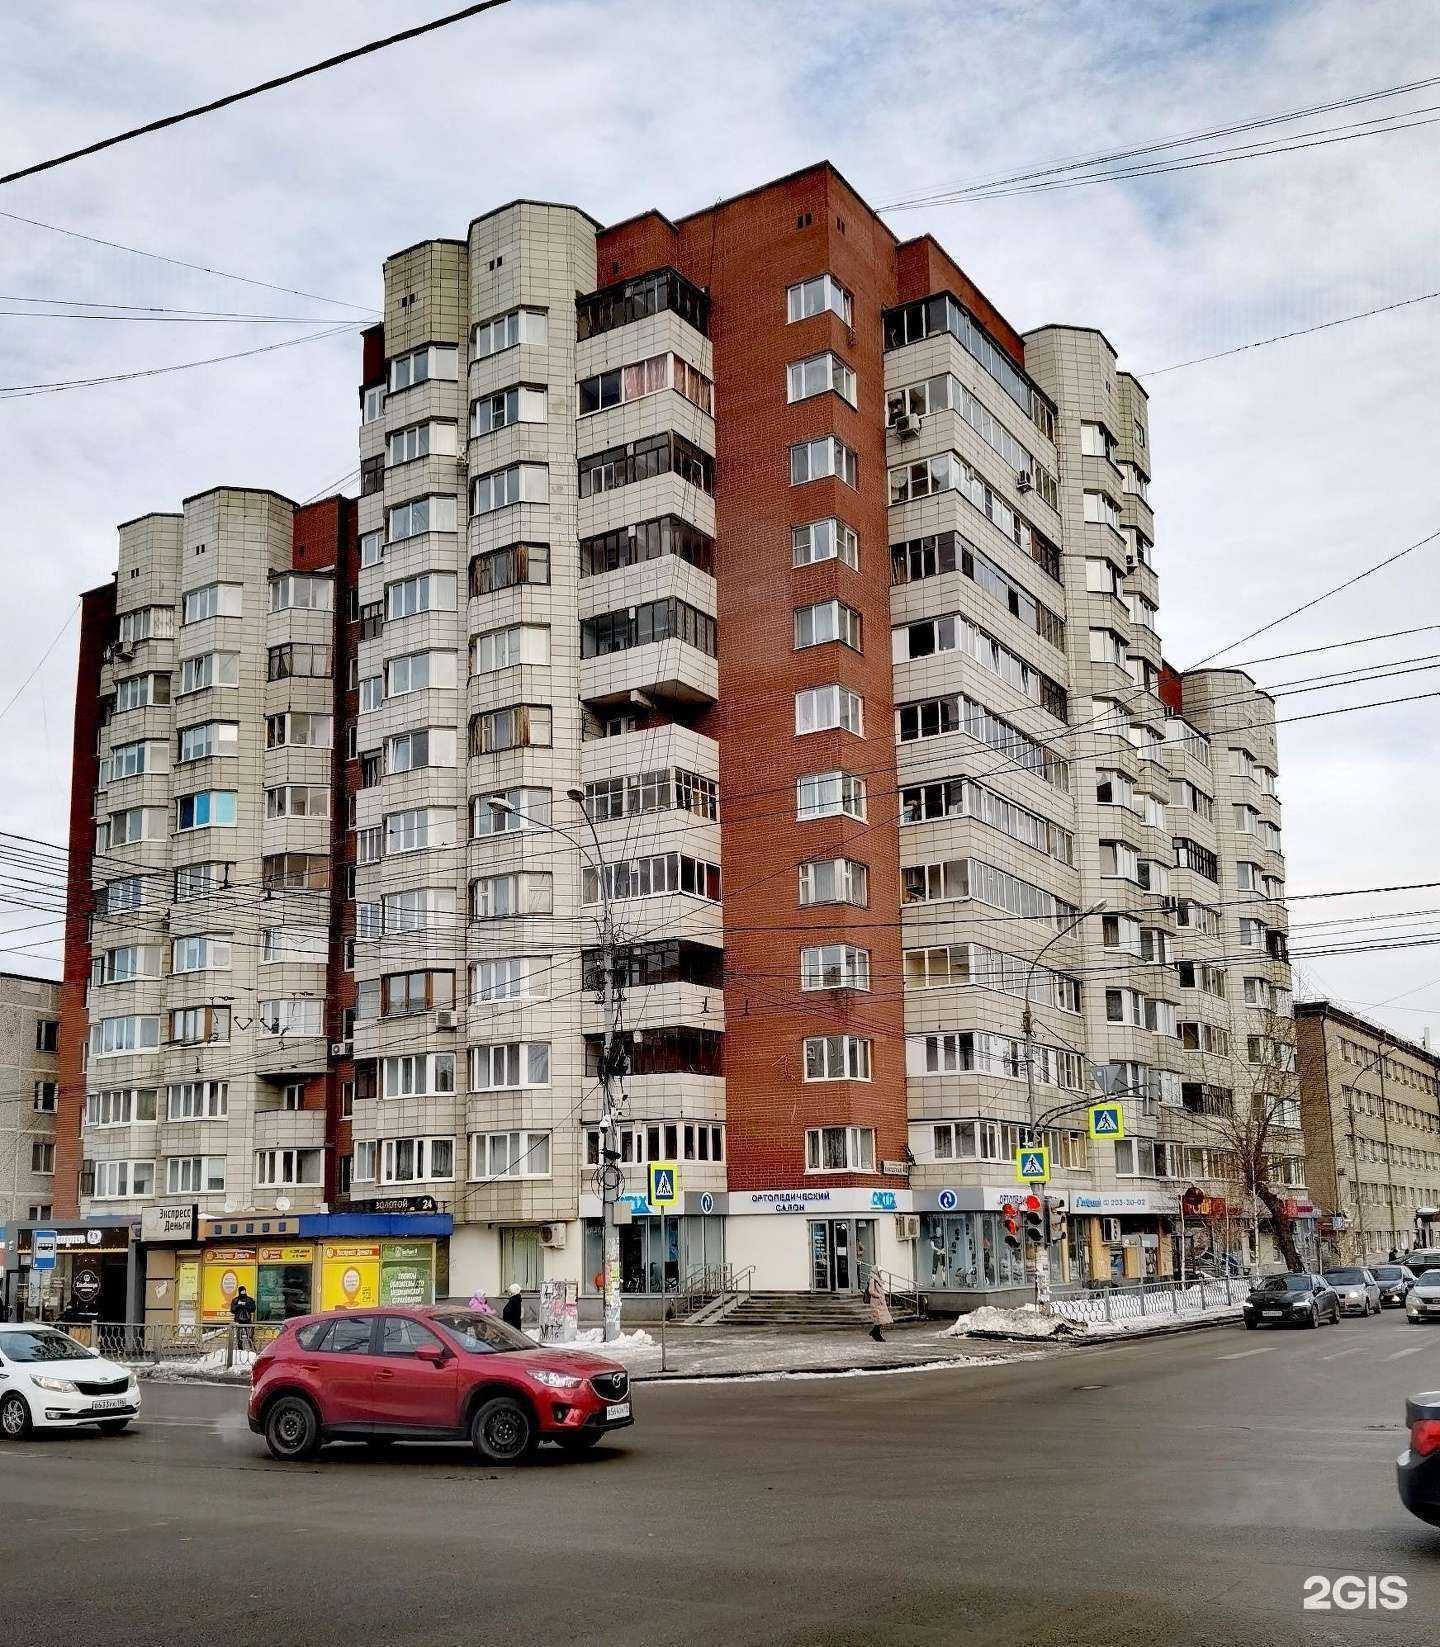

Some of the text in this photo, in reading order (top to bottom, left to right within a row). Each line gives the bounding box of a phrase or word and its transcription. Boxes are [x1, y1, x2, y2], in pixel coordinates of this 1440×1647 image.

[751, 1191, 831, 1202] ОРТОПЕДИЧЕСКИЙ
[375, 1199, 433, 1209] ЗОЛОТОЙ 24
[775, 1204, 805, 1212] САЛОН
[159, 1208, 191, 1219] Экспресс
[164, 1220, 191, 1232] Деньги
